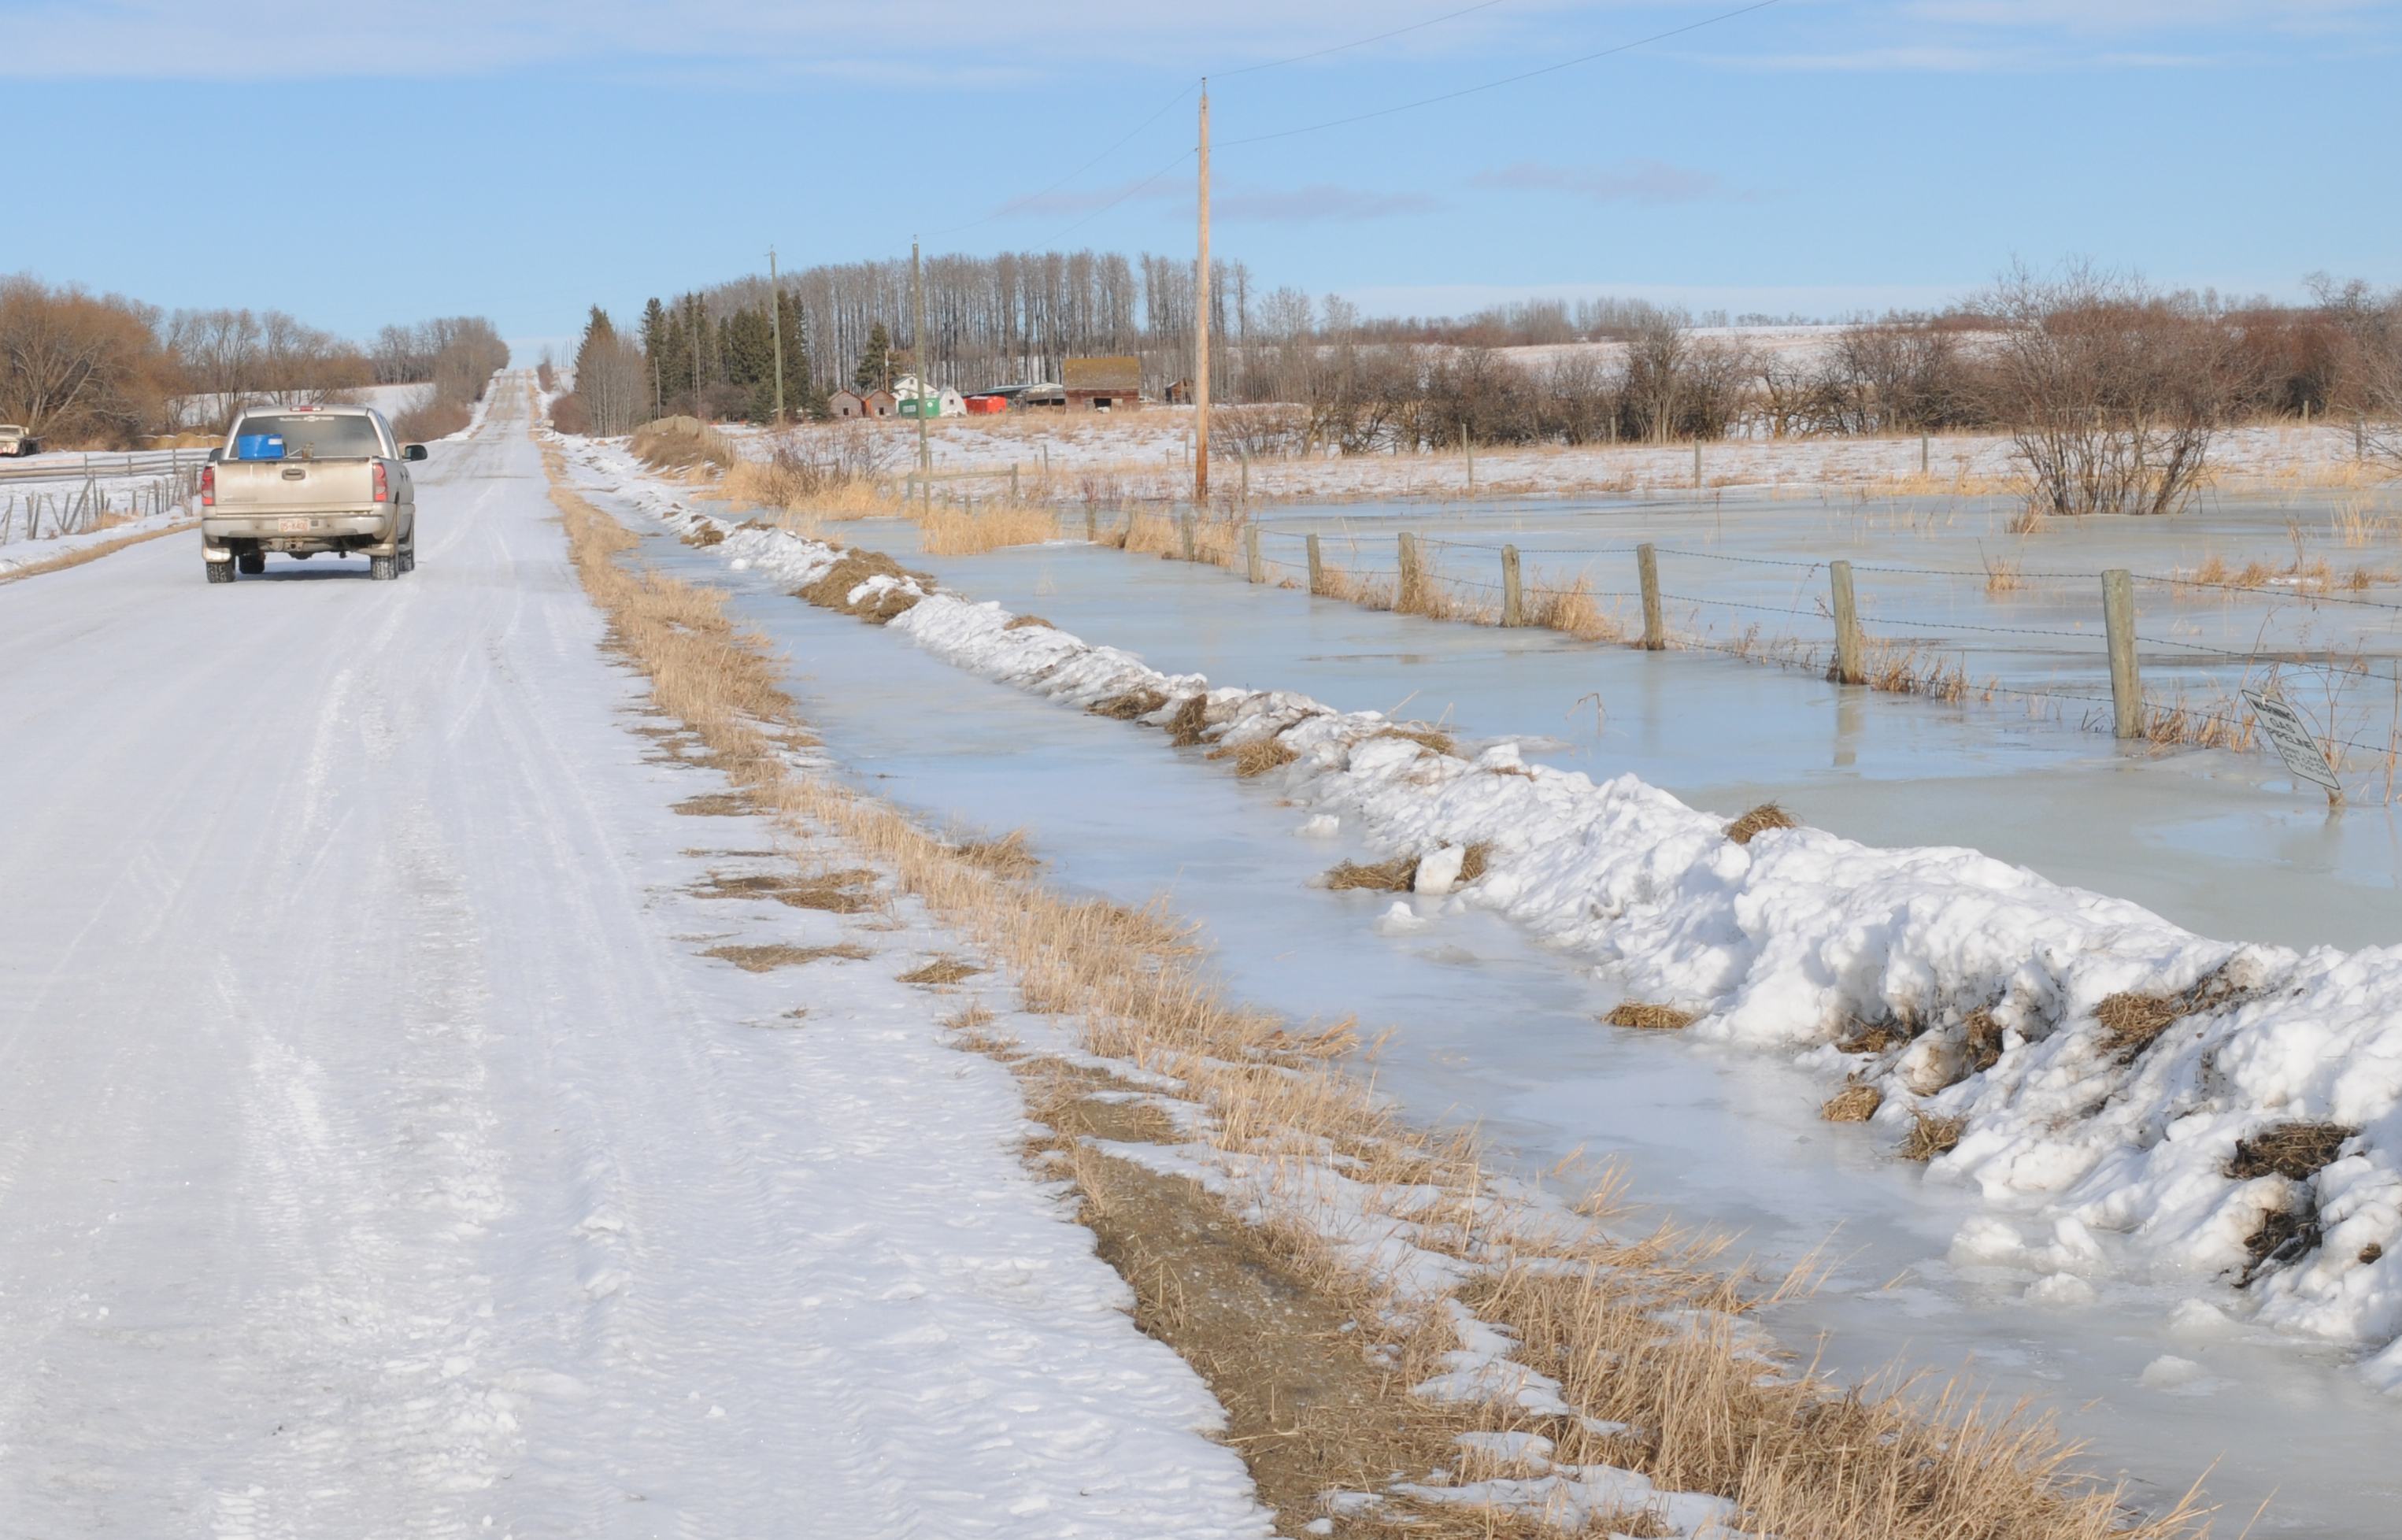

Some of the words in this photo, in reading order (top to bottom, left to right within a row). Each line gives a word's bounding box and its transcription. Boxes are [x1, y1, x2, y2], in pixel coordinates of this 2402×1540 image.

[2249, 698, 2297, 723] WARNING
[2269, 717, 2296, 734] GAS
[2266, 726, 2317, 752] PIPELINE
